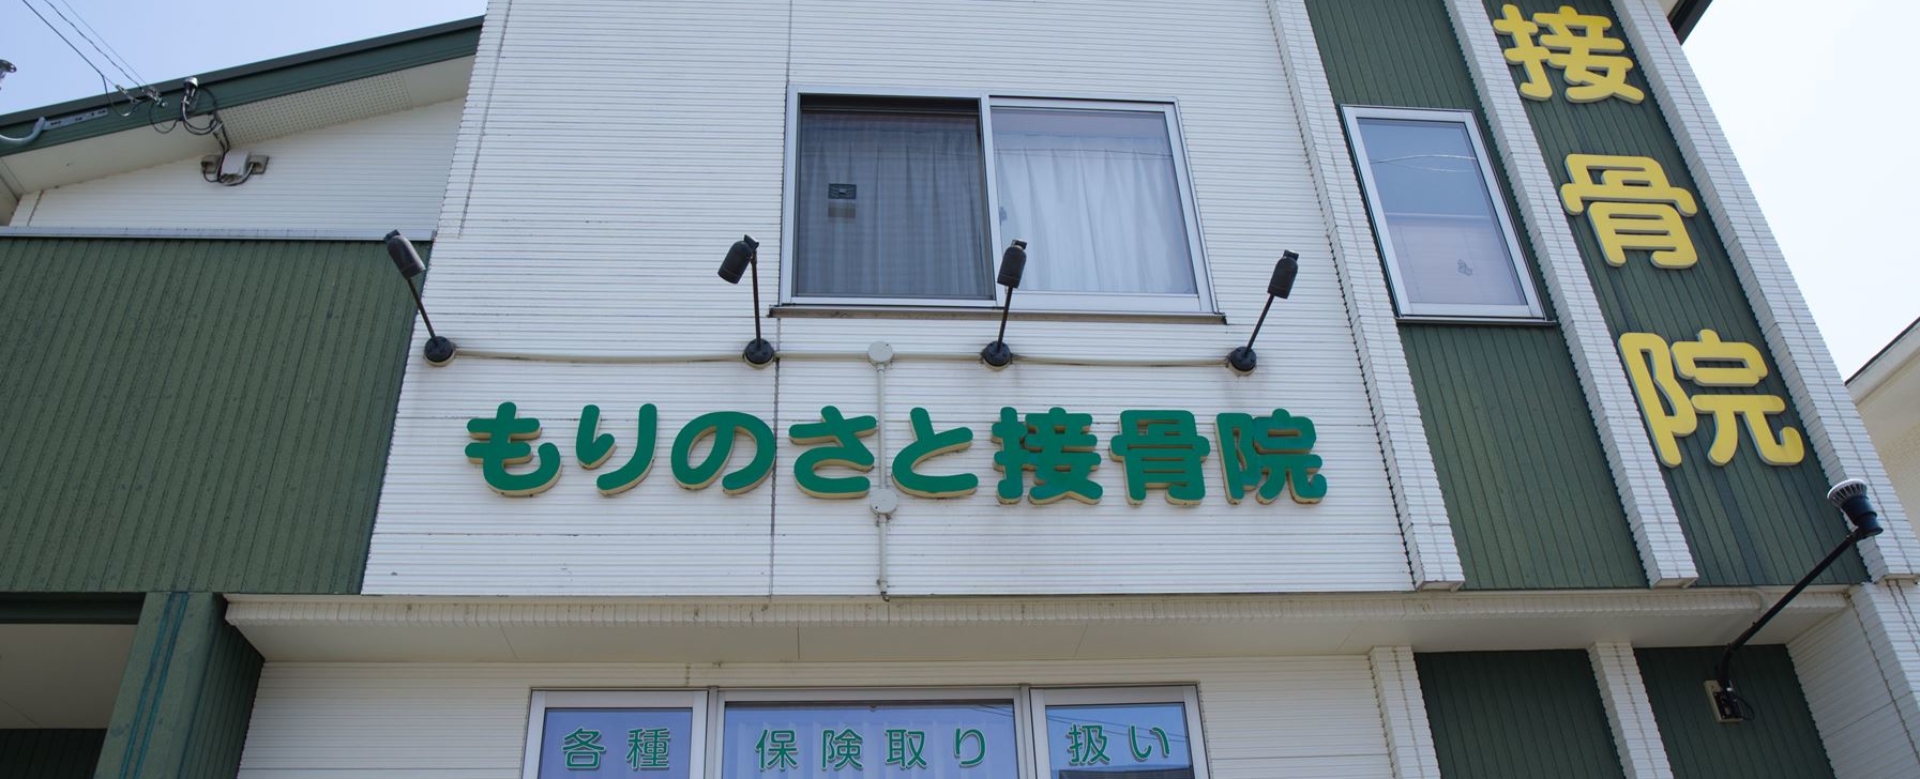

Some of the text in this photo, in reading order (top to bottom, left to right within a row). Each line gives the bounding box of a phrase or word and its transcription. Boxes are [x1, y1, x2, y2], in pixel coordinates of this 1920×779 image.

[1493, 3, 1805, 467] 接骨院
[464, 401, 1328, 507] もりのさと接骨院
